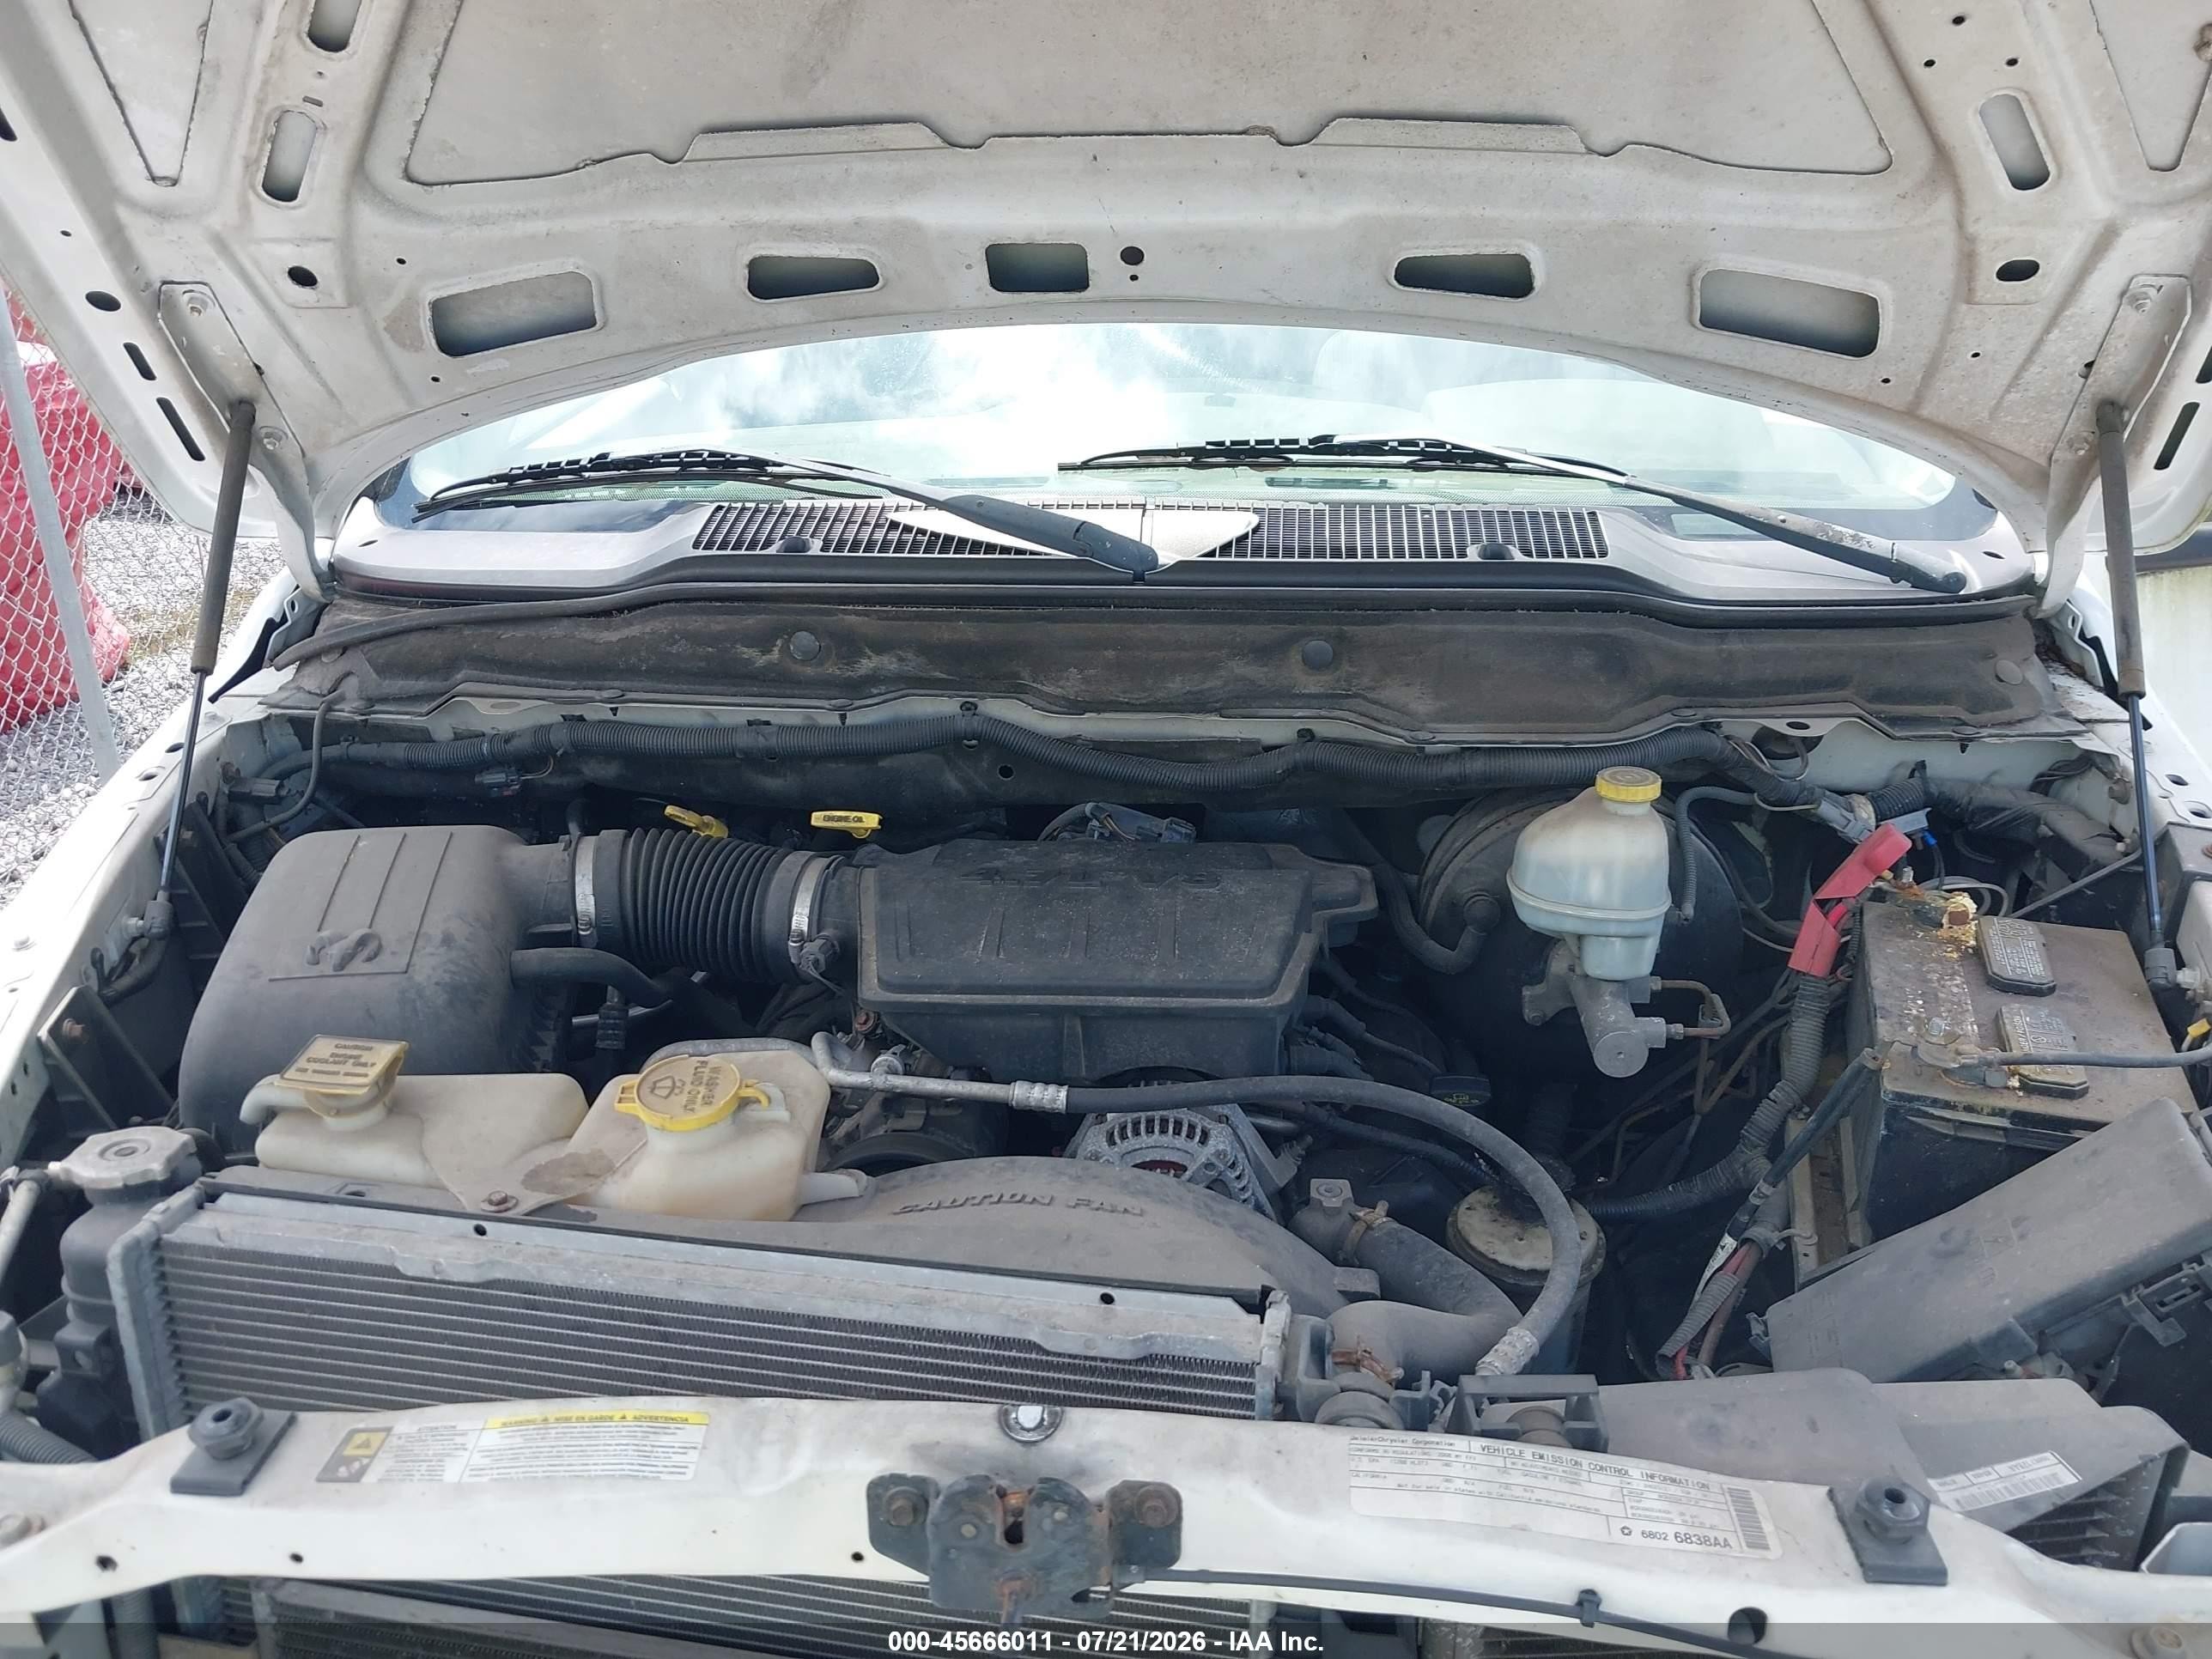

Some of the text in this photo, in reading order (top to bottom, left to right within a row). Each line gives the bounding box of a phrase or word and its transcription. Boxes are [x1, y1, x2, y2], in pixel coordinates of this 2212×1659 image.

[682, 1060, 708, 1113] FLUID ONLY
[701, 1065, 722, 1106] WASHER
[891, 1192, 1146, 1218] CAUTION FAN
[1480, 1444, 1526, 1458] VEHICLE
[1532, 1451, 1583, 1468] EMISSION
[1588, 1462, 1633, 1476] CONTROL
[1641, 1472, 1711, 1490] INFORMATION
[1641, 1529, 1733, 1549] 6802 6838AA
